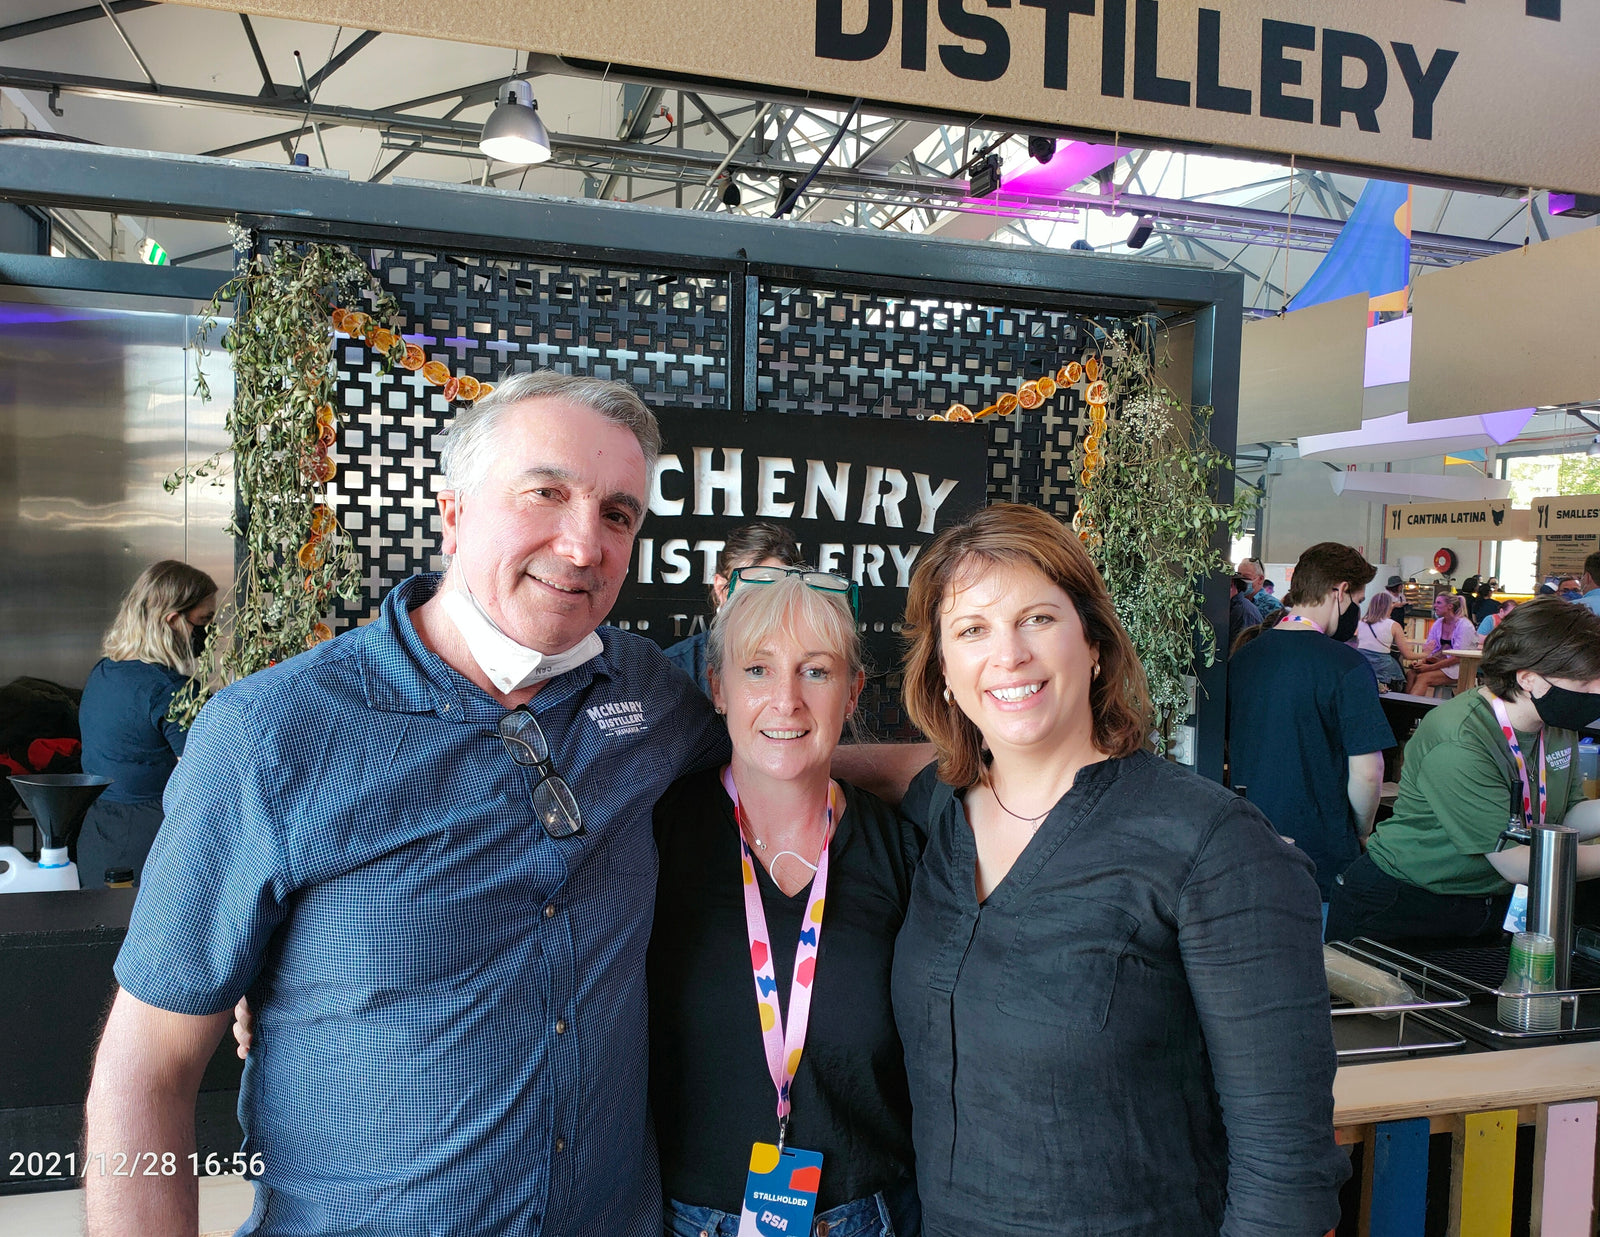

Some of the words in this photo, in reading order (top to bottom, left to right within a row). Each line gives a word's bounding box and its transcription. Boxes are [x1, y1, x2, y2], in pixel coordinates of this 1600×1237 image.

[815, 0, 1459, 140] DISTILLERY
[647, 446, 960, 535] CHENRY
[1407, 512, 1448, 525] CANTINA
[1451, 511, 1486, 523] LATINA
[1556, 508, 1600, 519] SMALLES
[627, 538, 922, 588] ISTERY
[597, 713, 645, 729] DISTILLERY
[753, 1191, 808, 1207] STALLHOLDER
[761, 1210, 788, 1231] RSA
